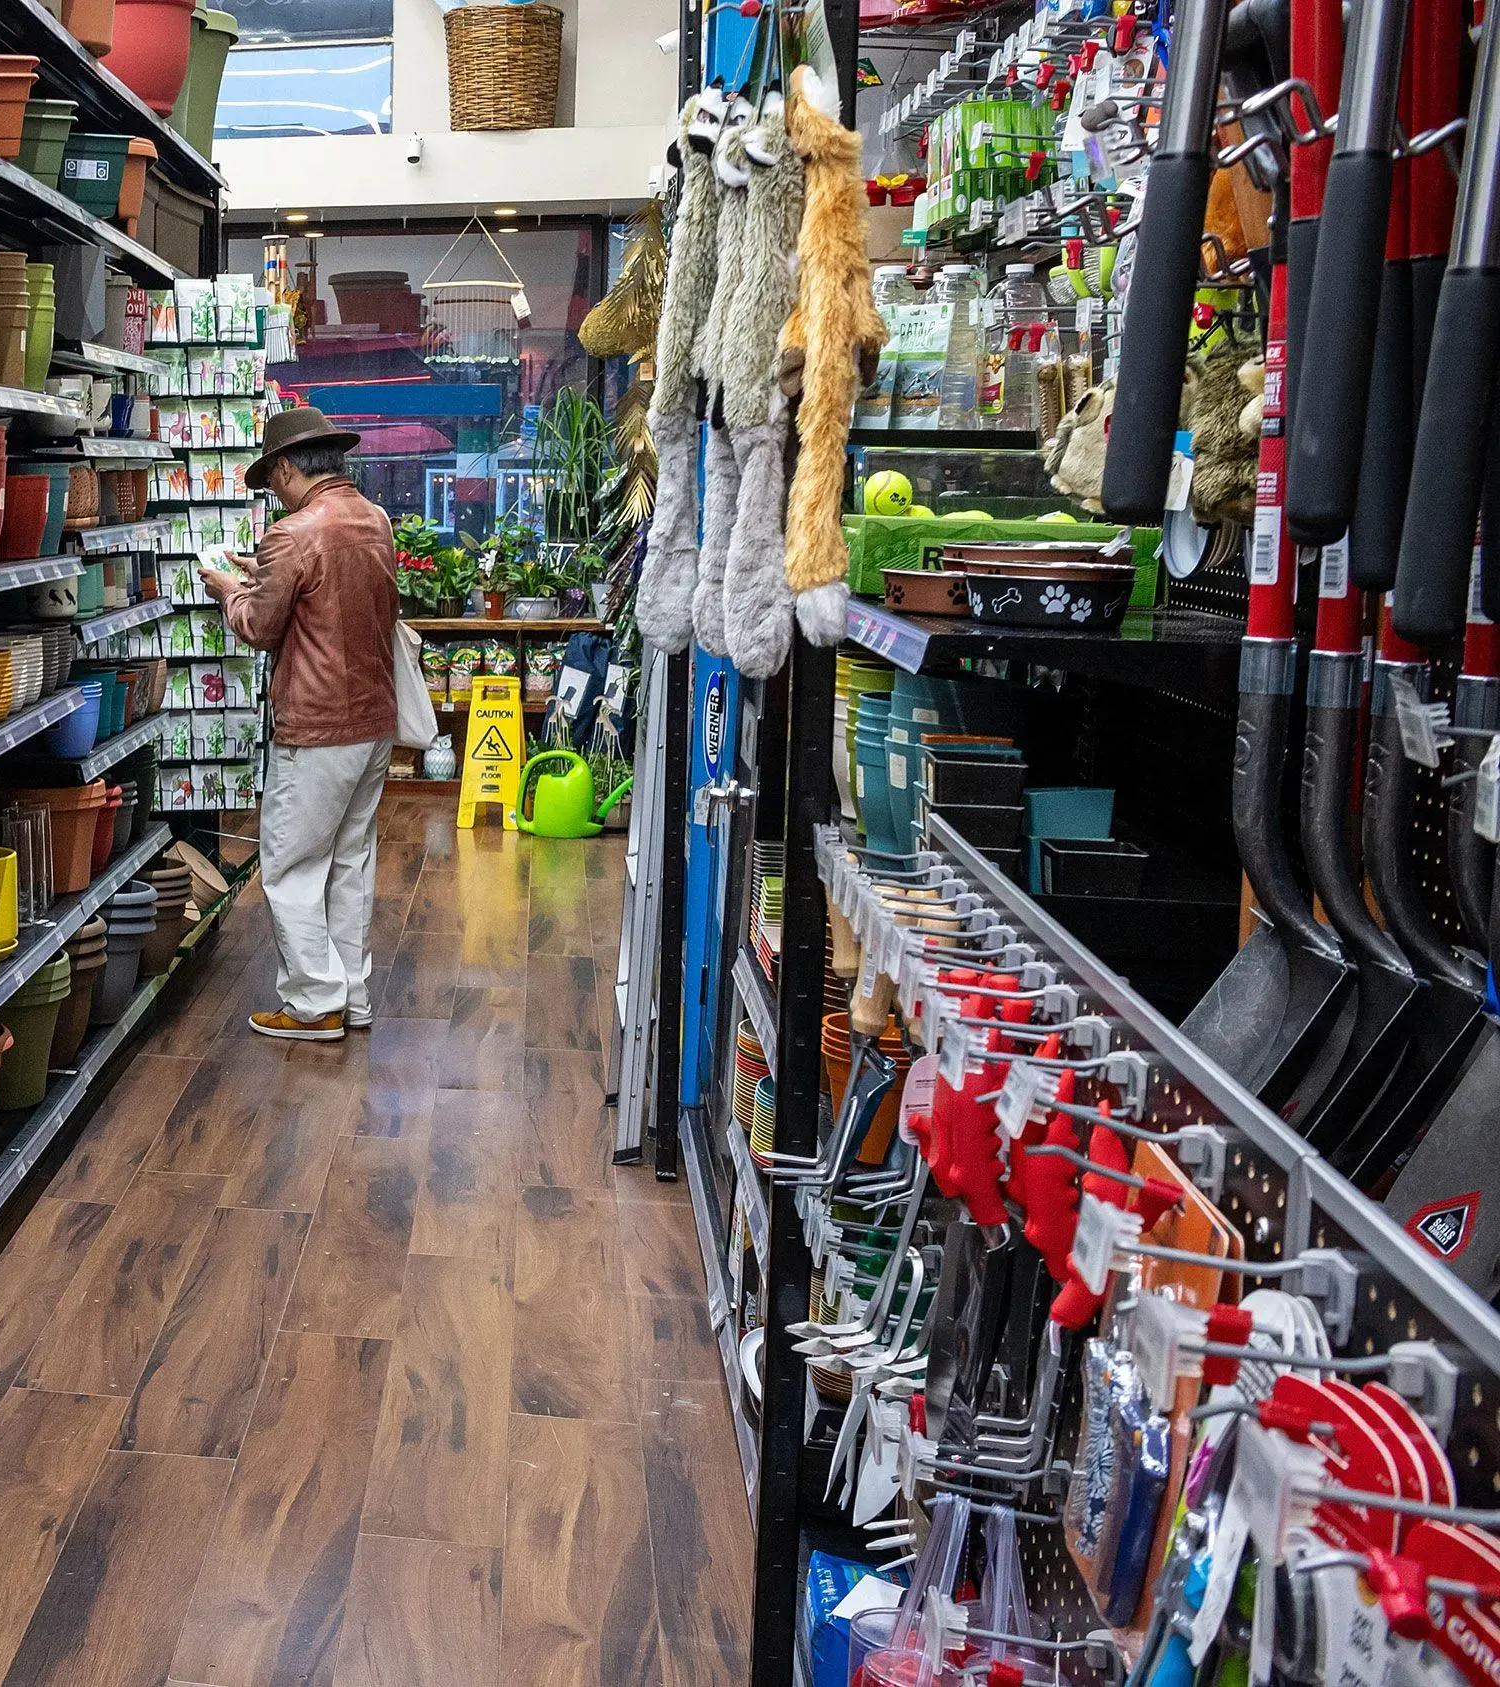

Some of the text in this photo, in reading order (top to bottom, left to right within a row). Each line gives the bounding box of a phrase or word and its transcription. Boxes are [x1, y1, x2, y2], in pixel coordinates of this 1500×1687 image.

[1266, 347, 1282, 358] CE
[476, 710, 514, 719] CAUTION
[709, 693, 720, 756] WERNER
[1433, 1217, 1456, 1241] STEPS
